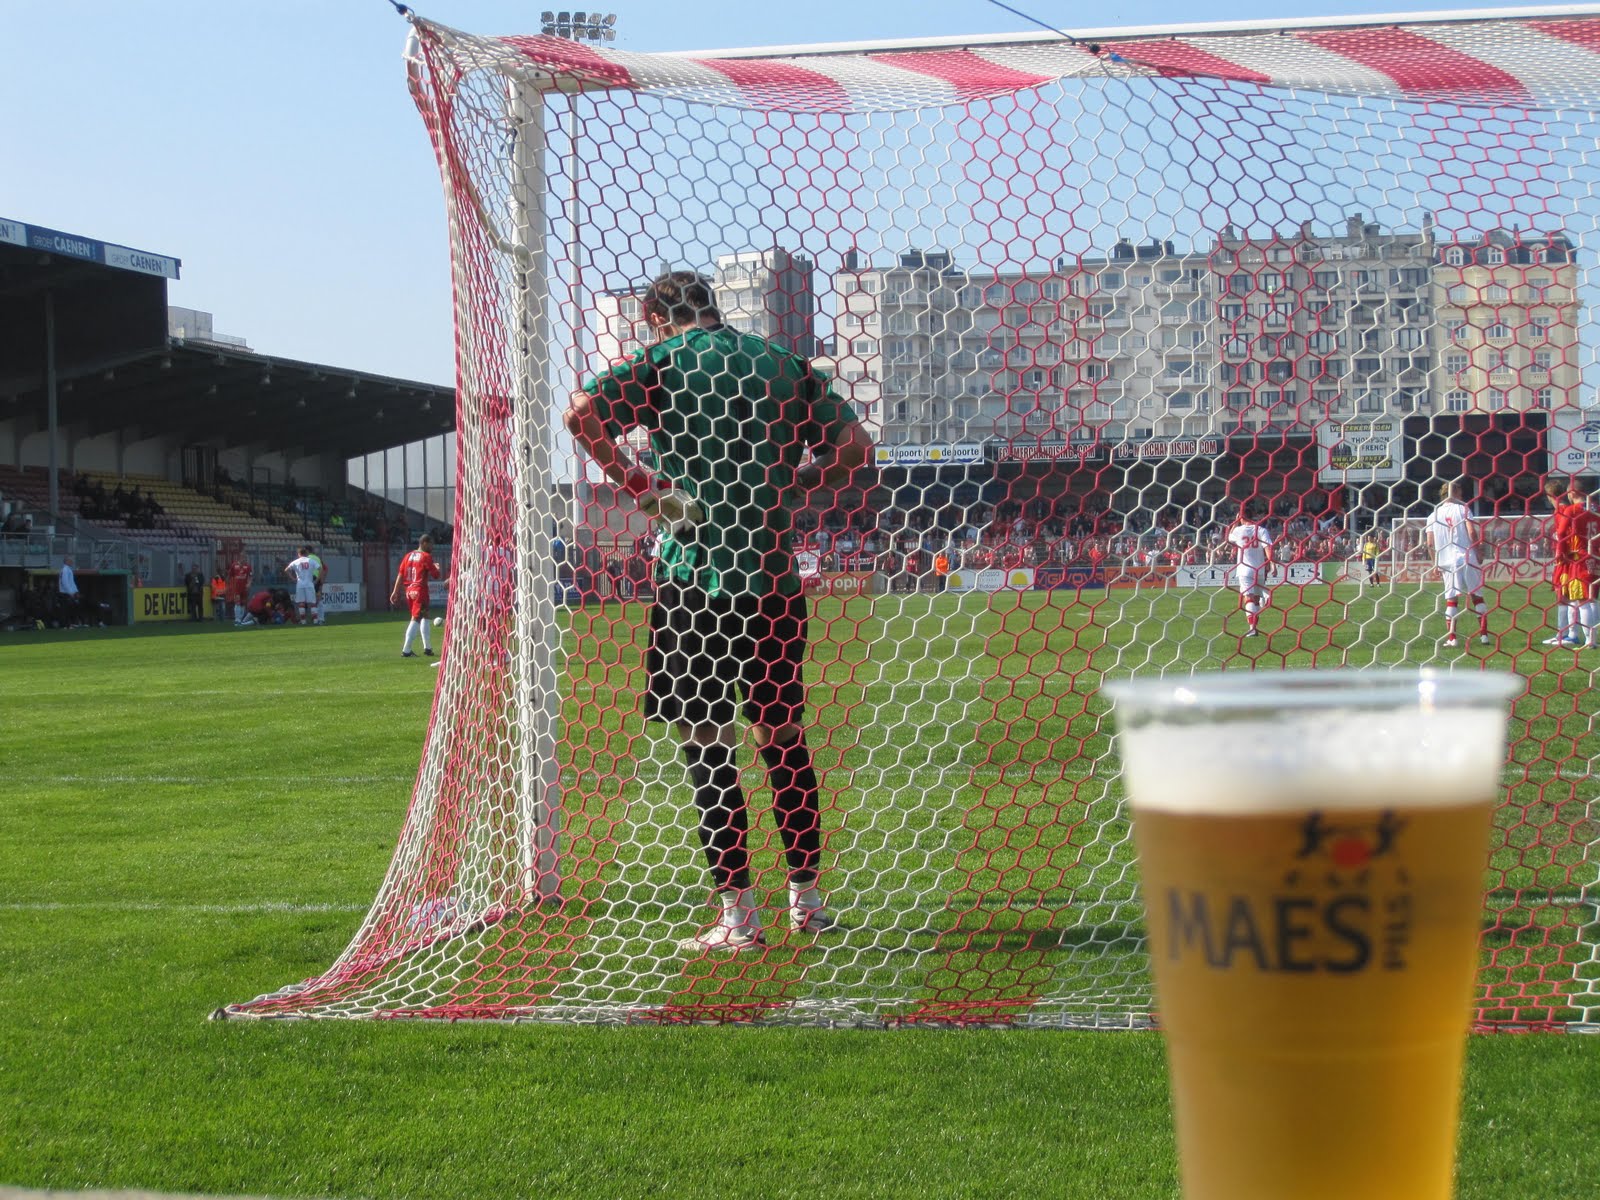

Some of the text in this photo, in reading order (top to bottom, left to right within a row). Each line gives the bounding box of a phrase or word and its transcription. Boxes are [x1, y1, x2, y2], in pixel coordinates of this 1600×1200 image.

[54, 236, 90, 257] CAENEN
[130, 254, 162, 273] CAENEN
[1331, 424, 1391, 433] VEZEKERIGEN
[889, 448, 929, 459] dpoortr
[301, 562, 309, 570] 10
[144, 593, 159, 615] DE
[1167, 887, 1373, 975] MAES
